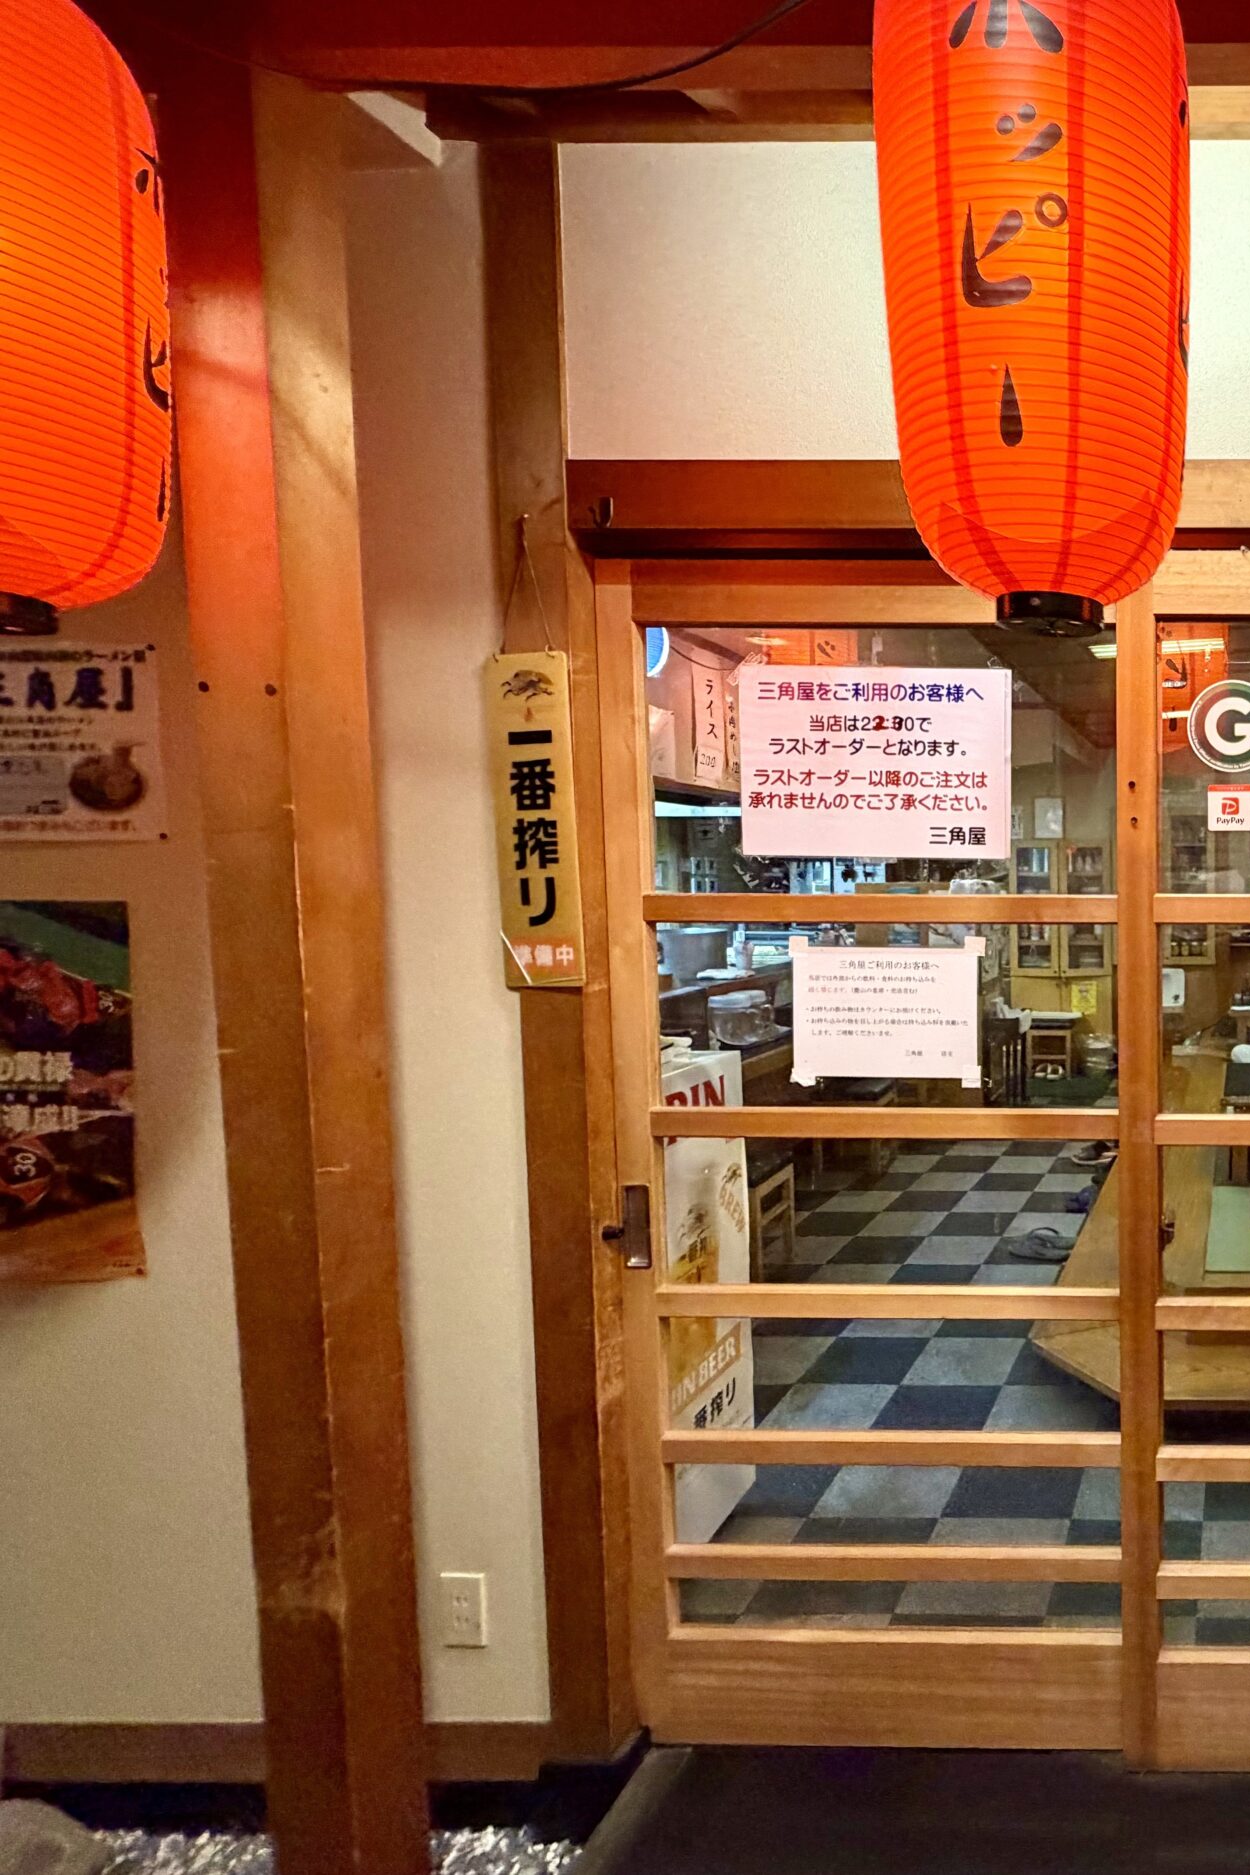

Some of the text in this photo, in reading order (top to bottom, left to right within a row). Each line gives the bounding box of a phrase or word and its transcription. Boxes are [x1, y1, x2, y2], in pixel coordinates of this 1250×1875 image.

[758, 682, 984, 703] 三角屋をご利用のお客様へ
[705, 679, 718, 739] ライス
[769, 738, 967, 757] ラストオーダーとなります。
[754, 769, 988, 788] ラストオーダー以降のご注文は
[749, 793, 988, 811] 承れませんのでご了承ください。
[508, 730, 560, 927] 一番搾り
[1216, 817, 1245, 826] PayPay
[929, 827, 987, 846] 三角屋
